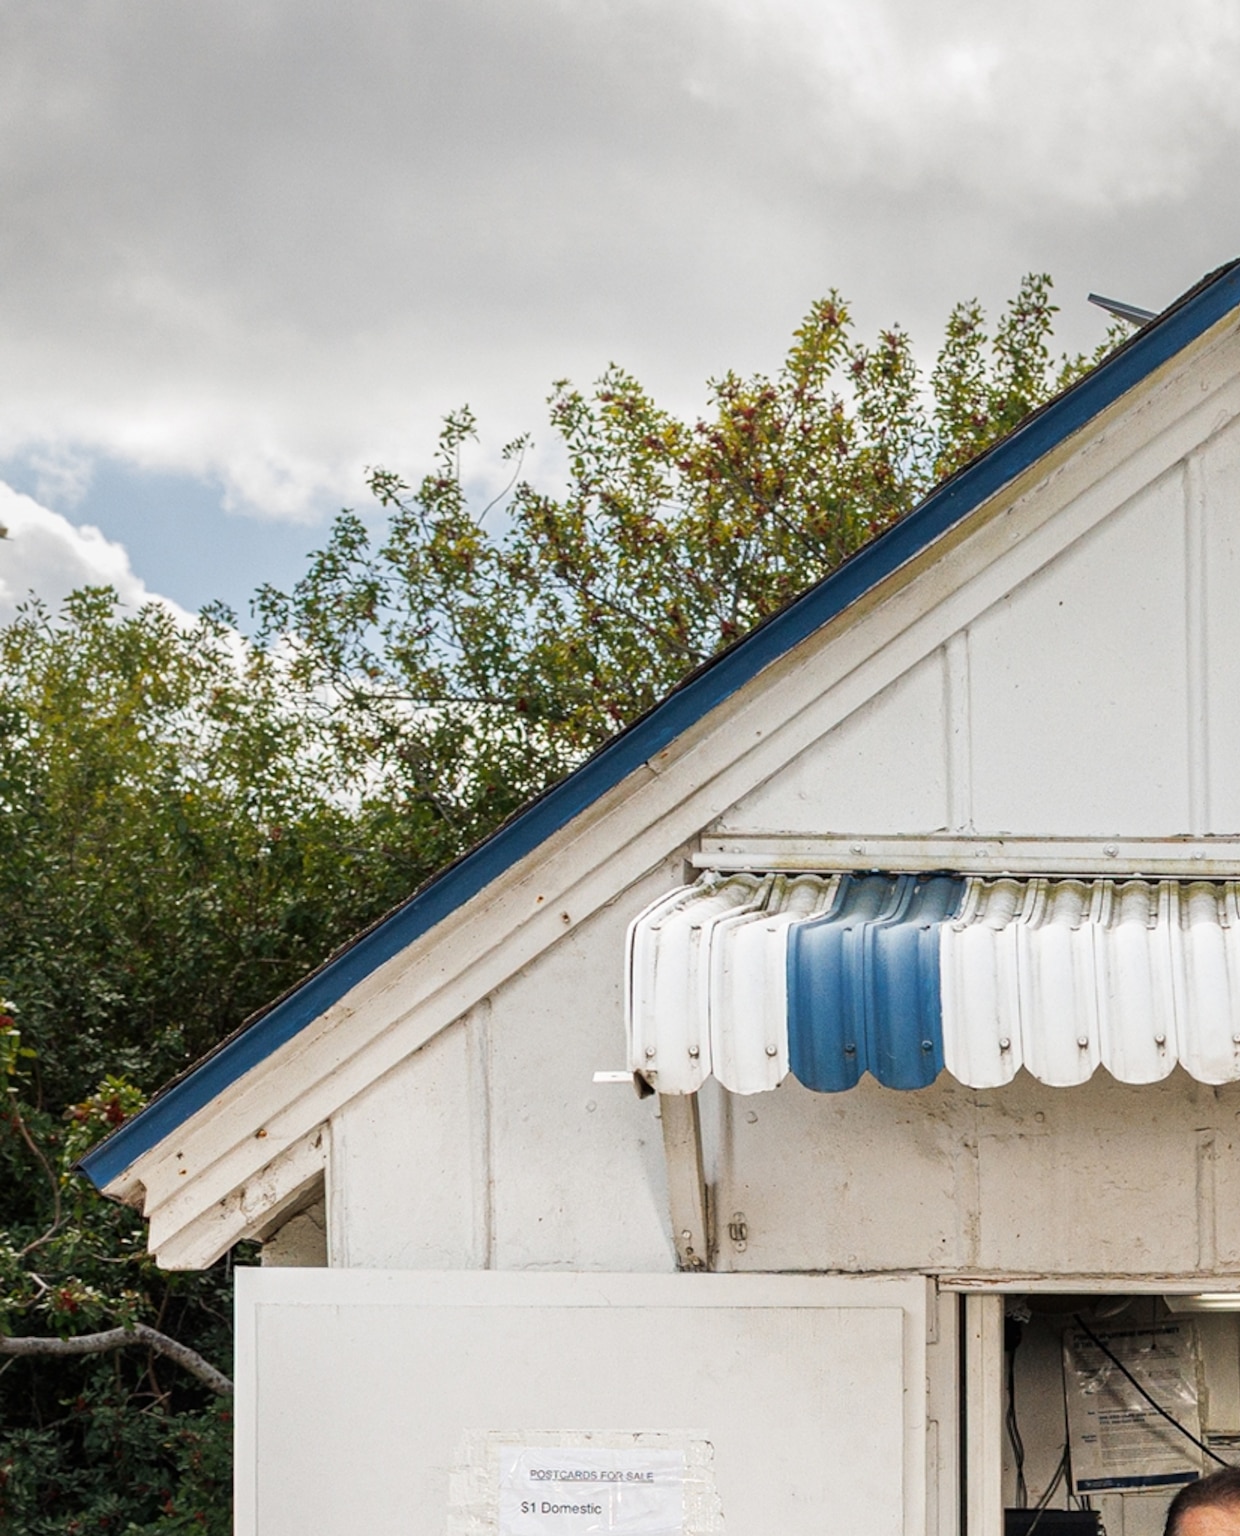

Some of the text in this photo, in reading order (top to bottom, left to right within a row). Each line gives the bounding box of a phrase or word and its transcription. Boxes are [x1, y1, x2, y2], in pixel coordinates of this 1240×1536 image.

[530, 1469, 654, 1481] POSTCARDS FOR SALE
[521, 1501, 602, 1515] $1 Domestic
